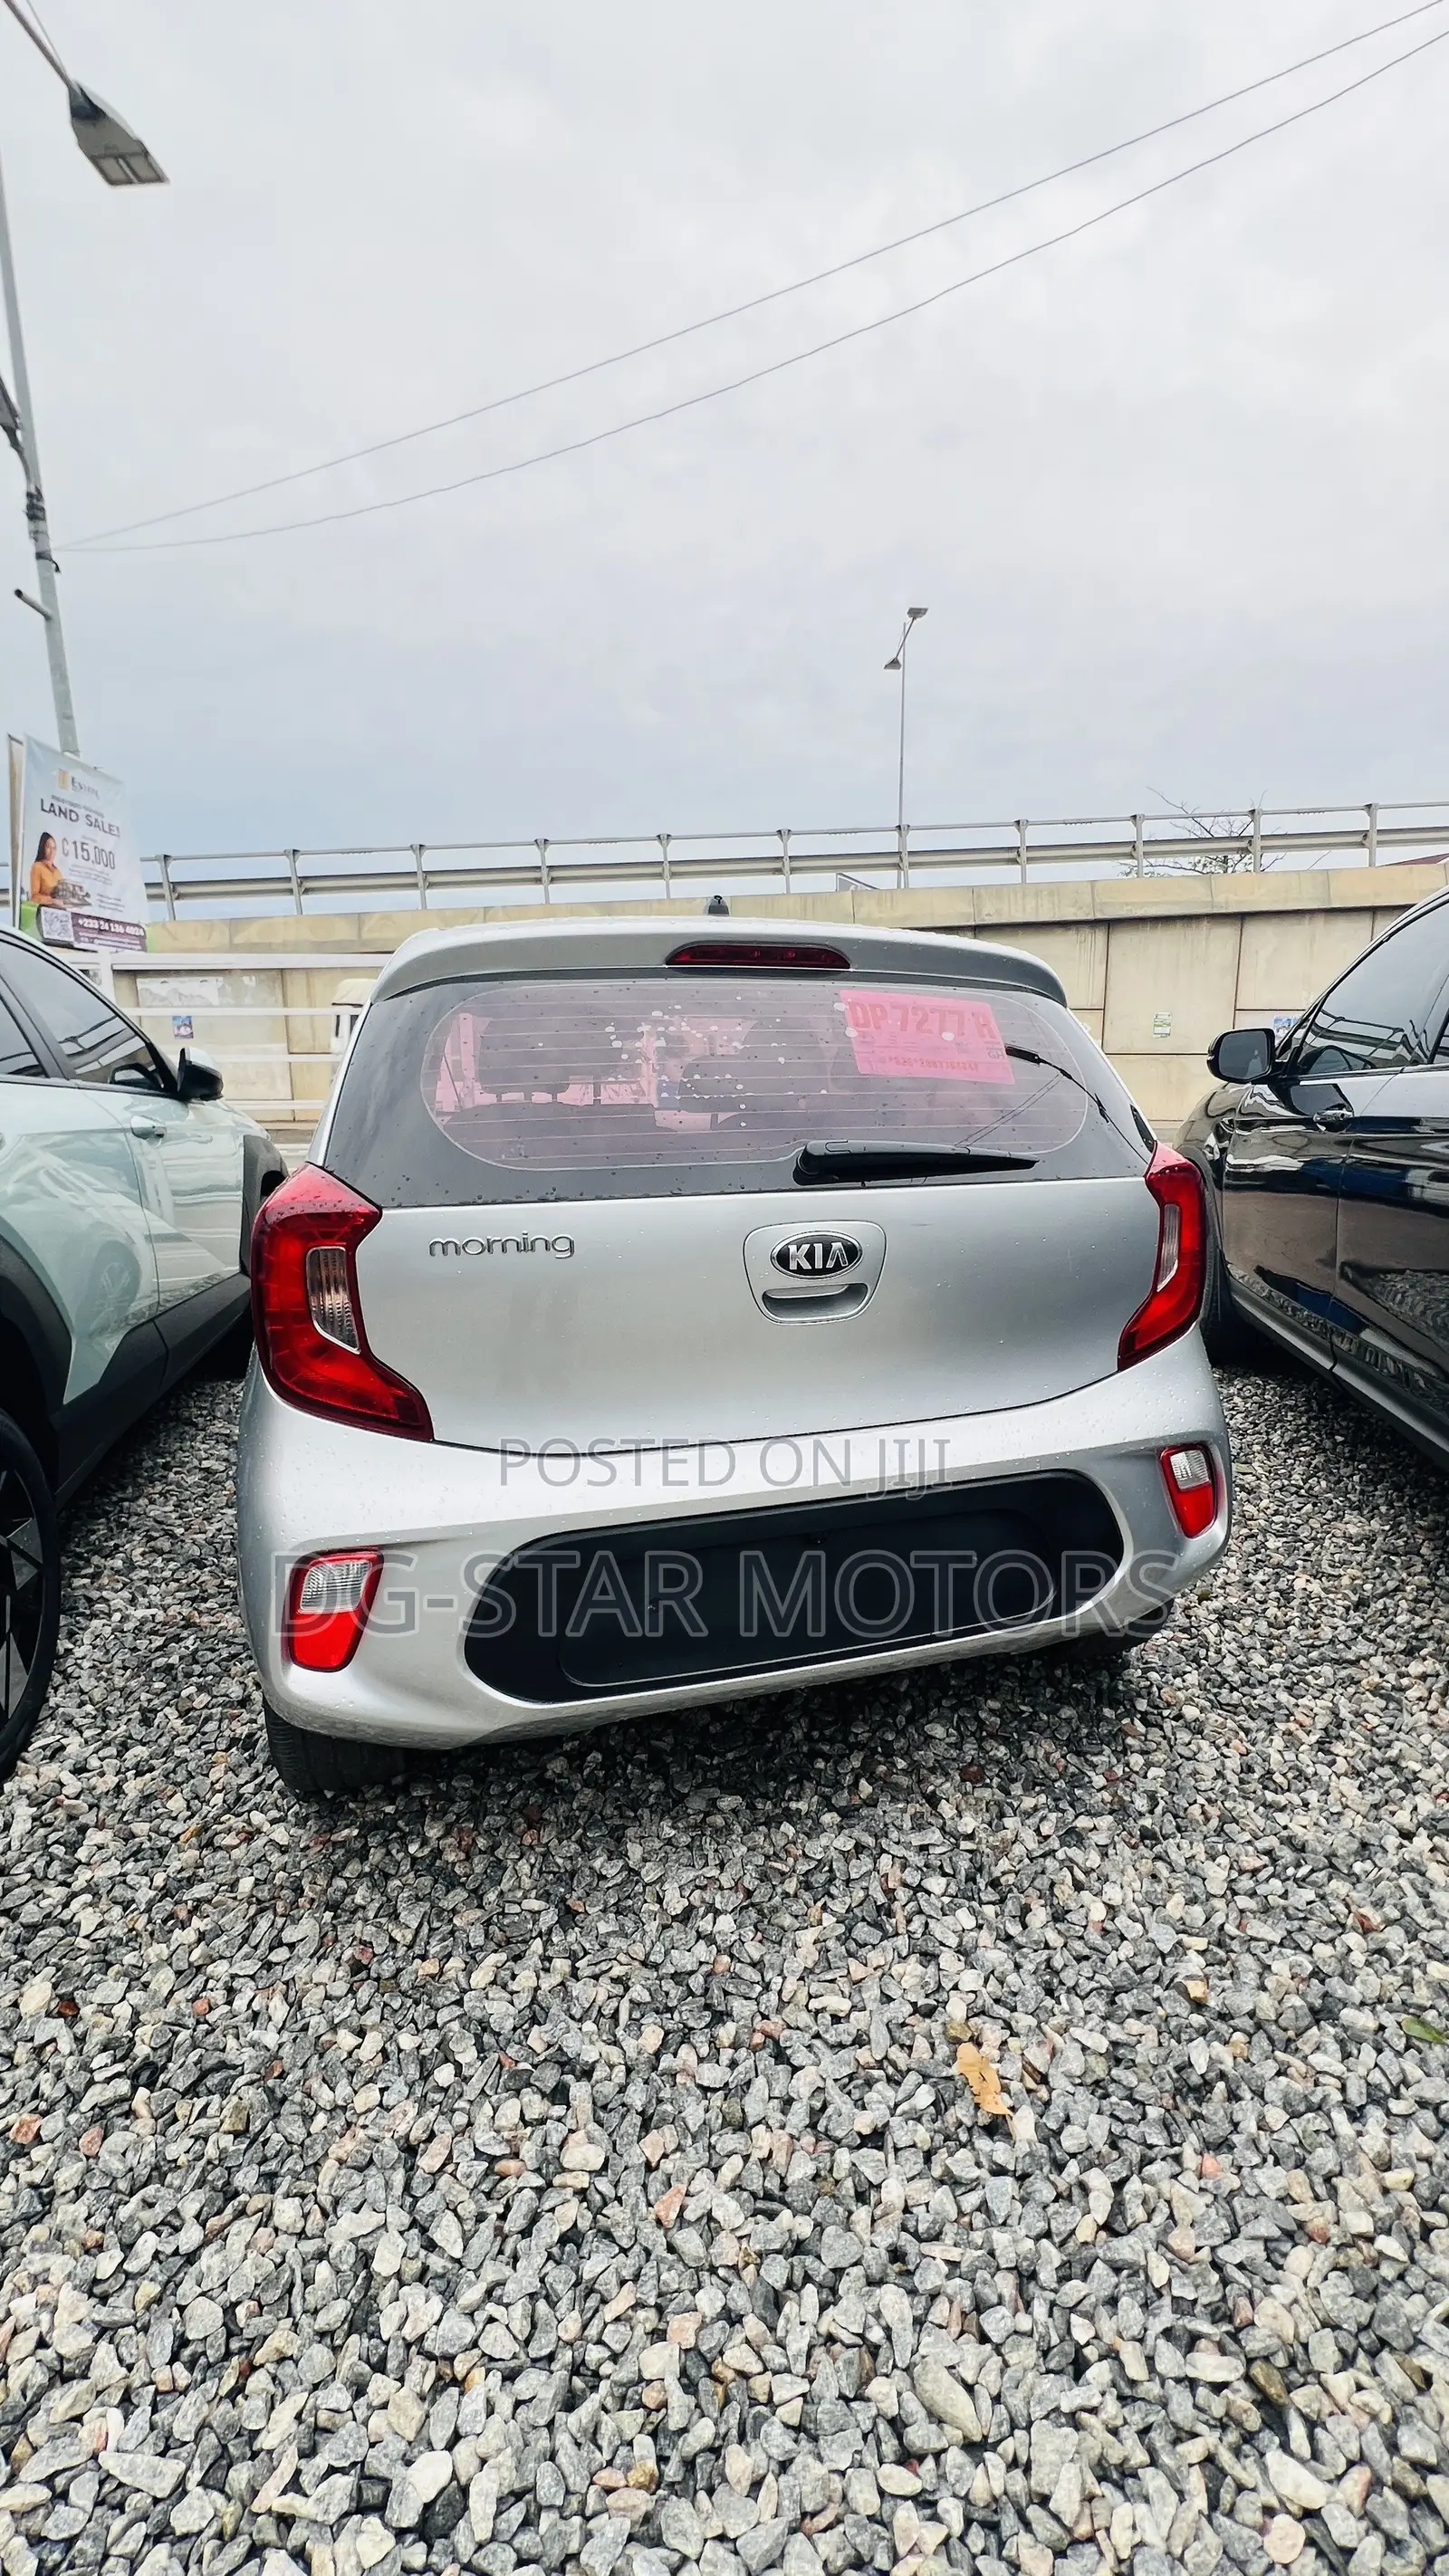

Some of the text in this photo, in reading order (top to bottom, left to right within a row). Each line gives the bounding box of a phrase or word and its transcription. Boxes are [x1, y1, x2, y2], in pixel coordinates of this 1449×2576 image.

[40, 798, 80, 823] LAND
[429, 1230, 575, 1259] morning
[787, 1241, 849, 1270] KIA
